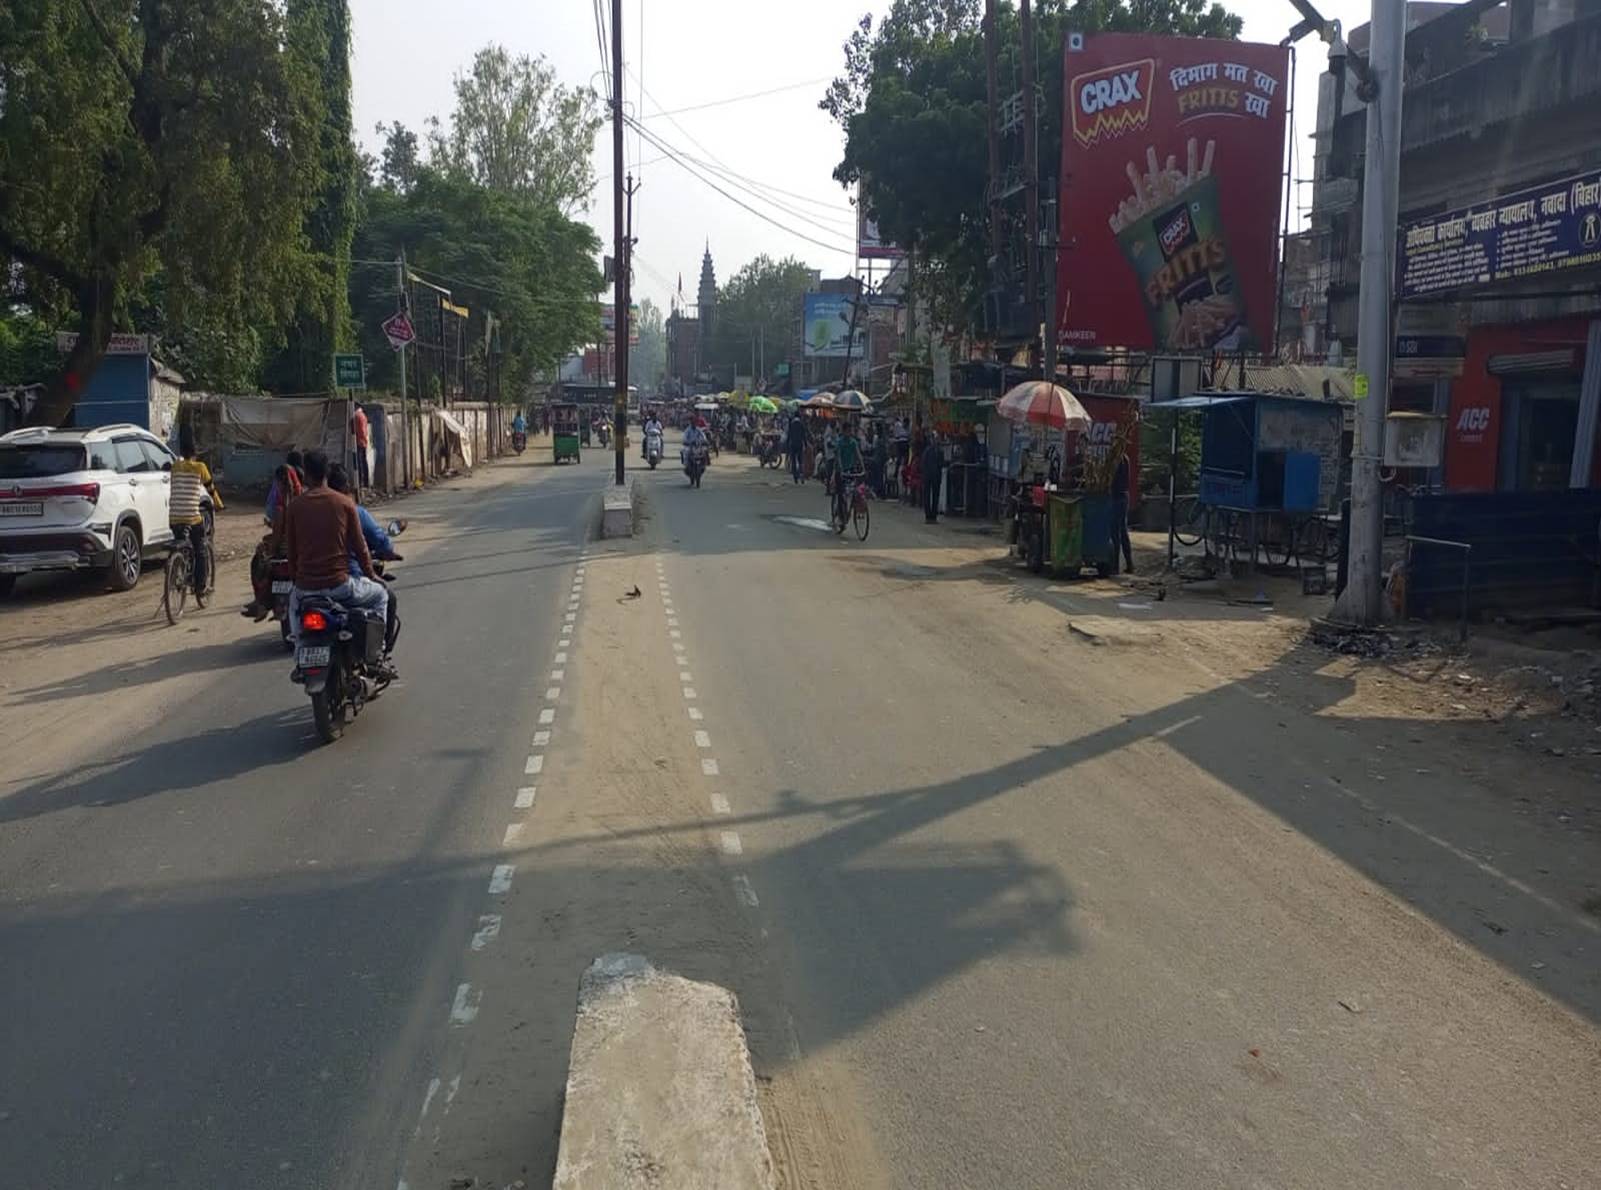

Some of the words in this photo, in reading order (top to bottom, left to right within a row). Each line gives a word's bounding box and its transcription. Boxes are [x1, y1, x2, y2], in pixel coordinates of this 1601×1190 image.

[1081, 70, 1142, 114] CRAX
[1170, 63, 1218, 91] दिमाग
[1223, 62, 1249, 83] मत
[1253, 69, 1278, 96] खा
[1178, 87, 1239, 113] FRITTS
[1245, 91, 1271, 118] खा
[1499, 200, 1538, 223] न्यायालय,
[1541, 191, 1568, 216] नवादा
[1163, 217, 1186, 244] CRAX
[1456, 407, 1490, 431] ACC
